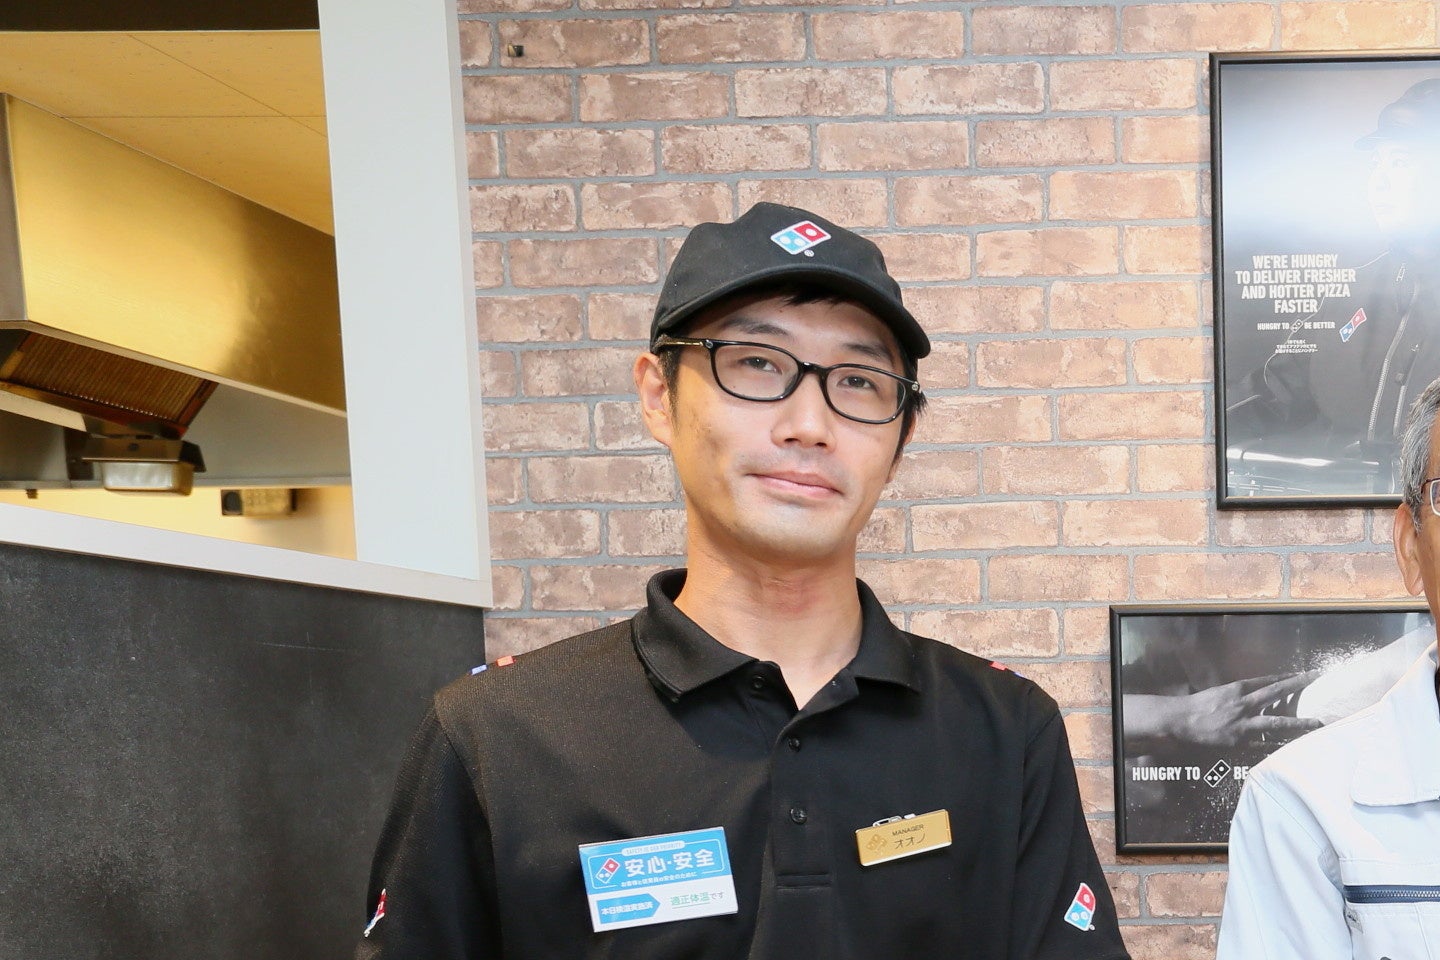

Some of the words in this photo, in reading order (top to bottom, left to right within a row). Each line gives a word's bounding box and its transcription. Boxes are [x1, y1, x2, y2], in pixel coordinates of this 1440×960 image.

[1253, 255, 1288, 269] WE'RE
[1291, 254, 1338, 268] HUNGRY
[1235, 271, 1251, 284] TO
[1253, 270, 1300, 284] DELIVER
[1304, 269, 1356, 283] FRESHER
[1242, 286, 1266, 299] AND
[1269, 285, 1314, 298] HOTTER
[1317, 284, 1351, 297] PIZZA
[1274, 299, 1318, 313] FASTER
[1282, 322, 1290, 330] TO
[1313, 321, 1335, 329] BETTER
[1132, 766, 1181, 782] HUNGRY
[1185, 765, 1201, 781] TO
[1233, 765, 1249, 780] BE
[892, 824, 925, 836] MANAGER
[894, 832, 926, 849] オオノ
